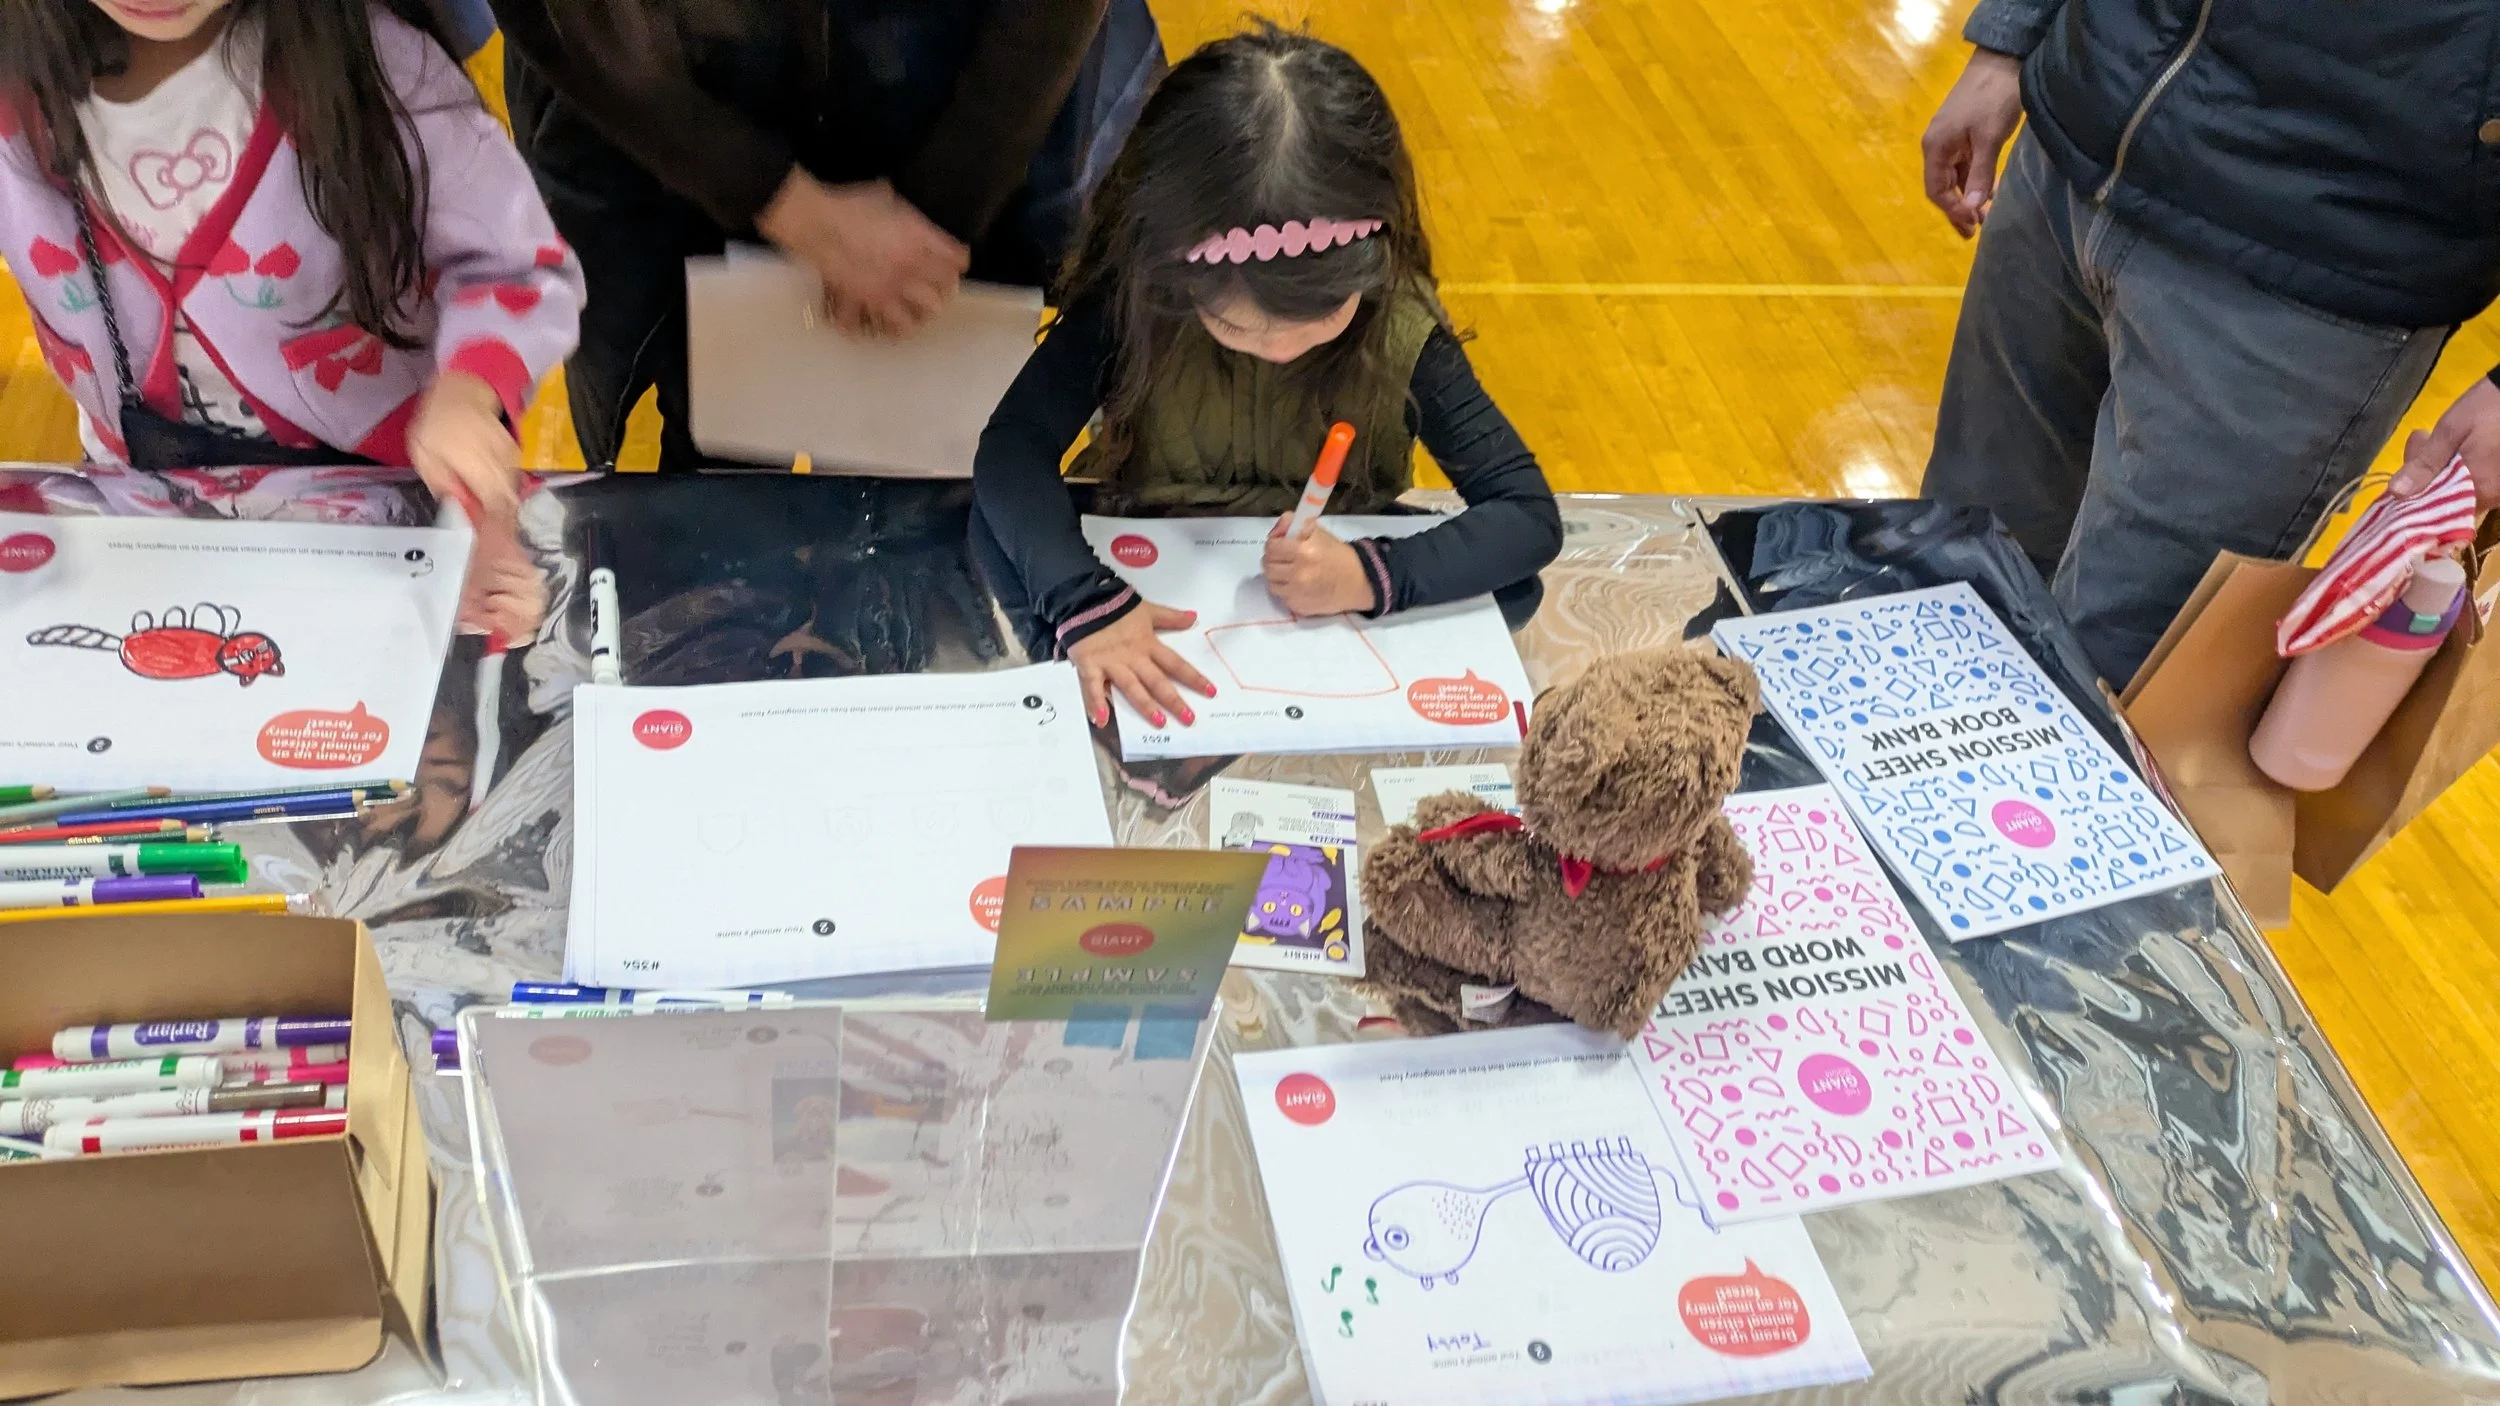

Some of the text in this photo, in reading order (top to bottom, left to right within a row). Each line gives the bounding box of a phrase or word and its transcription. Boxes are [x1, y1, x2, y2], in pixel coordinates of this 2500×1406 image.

[1411, 690, 1467, 702] imaginary
[1469, 694, 1484, 702] an
[1421, 701, 1499, 711] animal citizen
[1427, 711, 1442, 719] an
[1461, 711, 1498, 720] Dream
[265, 724, 383, 744] for an imaginary
[641, 723, 684, 735] GIANT
[1861, 707, 2022, 752] BOOK BANK
[271, 738, 371, 754] animal citizen
[1861, 726, 2063, 782] MISSION SHEET
[271, 748, 362, 765] Dream up an
[1679, 936, 1867, 981] WORD BAN
[1655, 963, 1907, 1019] MISSION SHEET
[1812, 1075, 1859, 1094] GIANT
[1285, 1092, 1327, 1107] GIANT
[1685, 1297, 1799, 1316] for an imaginary
[1699, 1314, 1795, 1332] animal citizen
[1708, 1328, 1798, 1345] Dream up an
